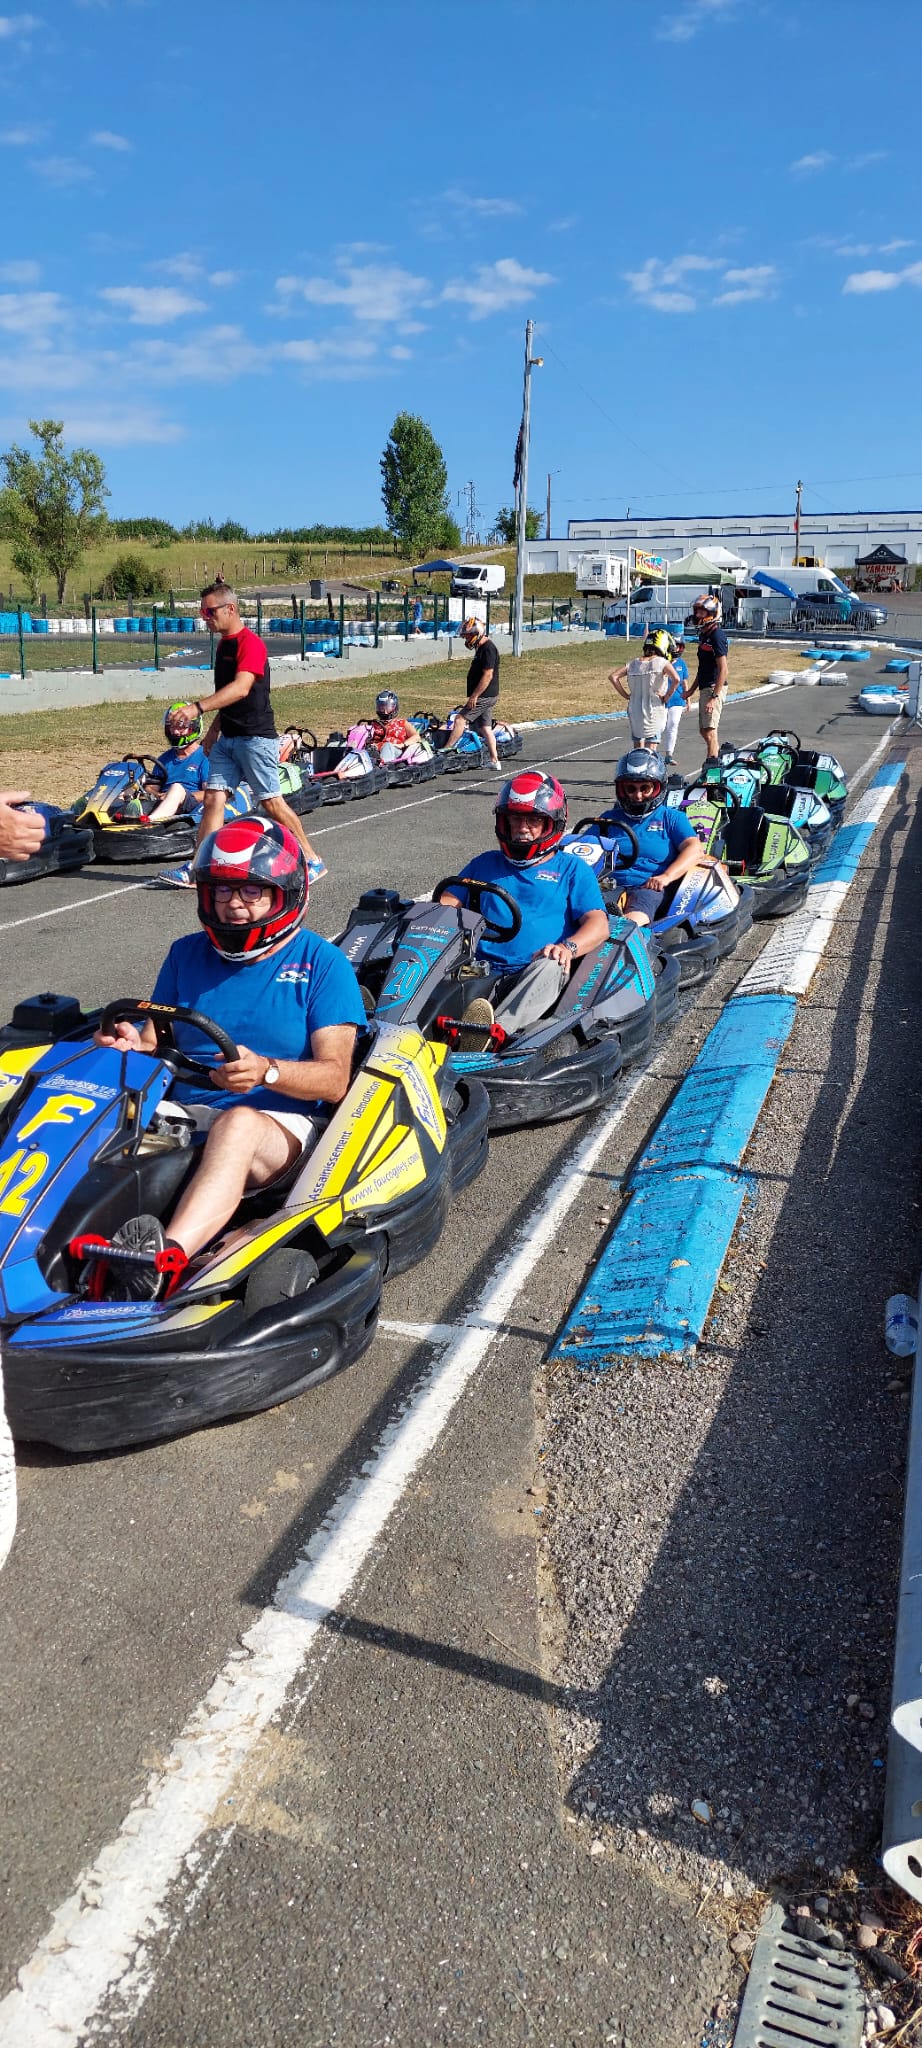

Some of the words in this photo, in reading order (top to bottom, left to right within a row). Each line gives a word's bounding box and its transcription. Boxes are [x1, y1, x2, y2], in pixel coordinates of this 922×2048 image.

[866, 564, 897, 575] YAMAHA
[381, 960, 422, 997] 20
[16, 1093, 96, 1143] F
[309, 1131, 352, 1201] Assainissement
[351, 1080, 382, 1119] Démolition
[0, 1149, 49, 1218] 12
[349, 1152, 421, 1205] www.faucogney.com
